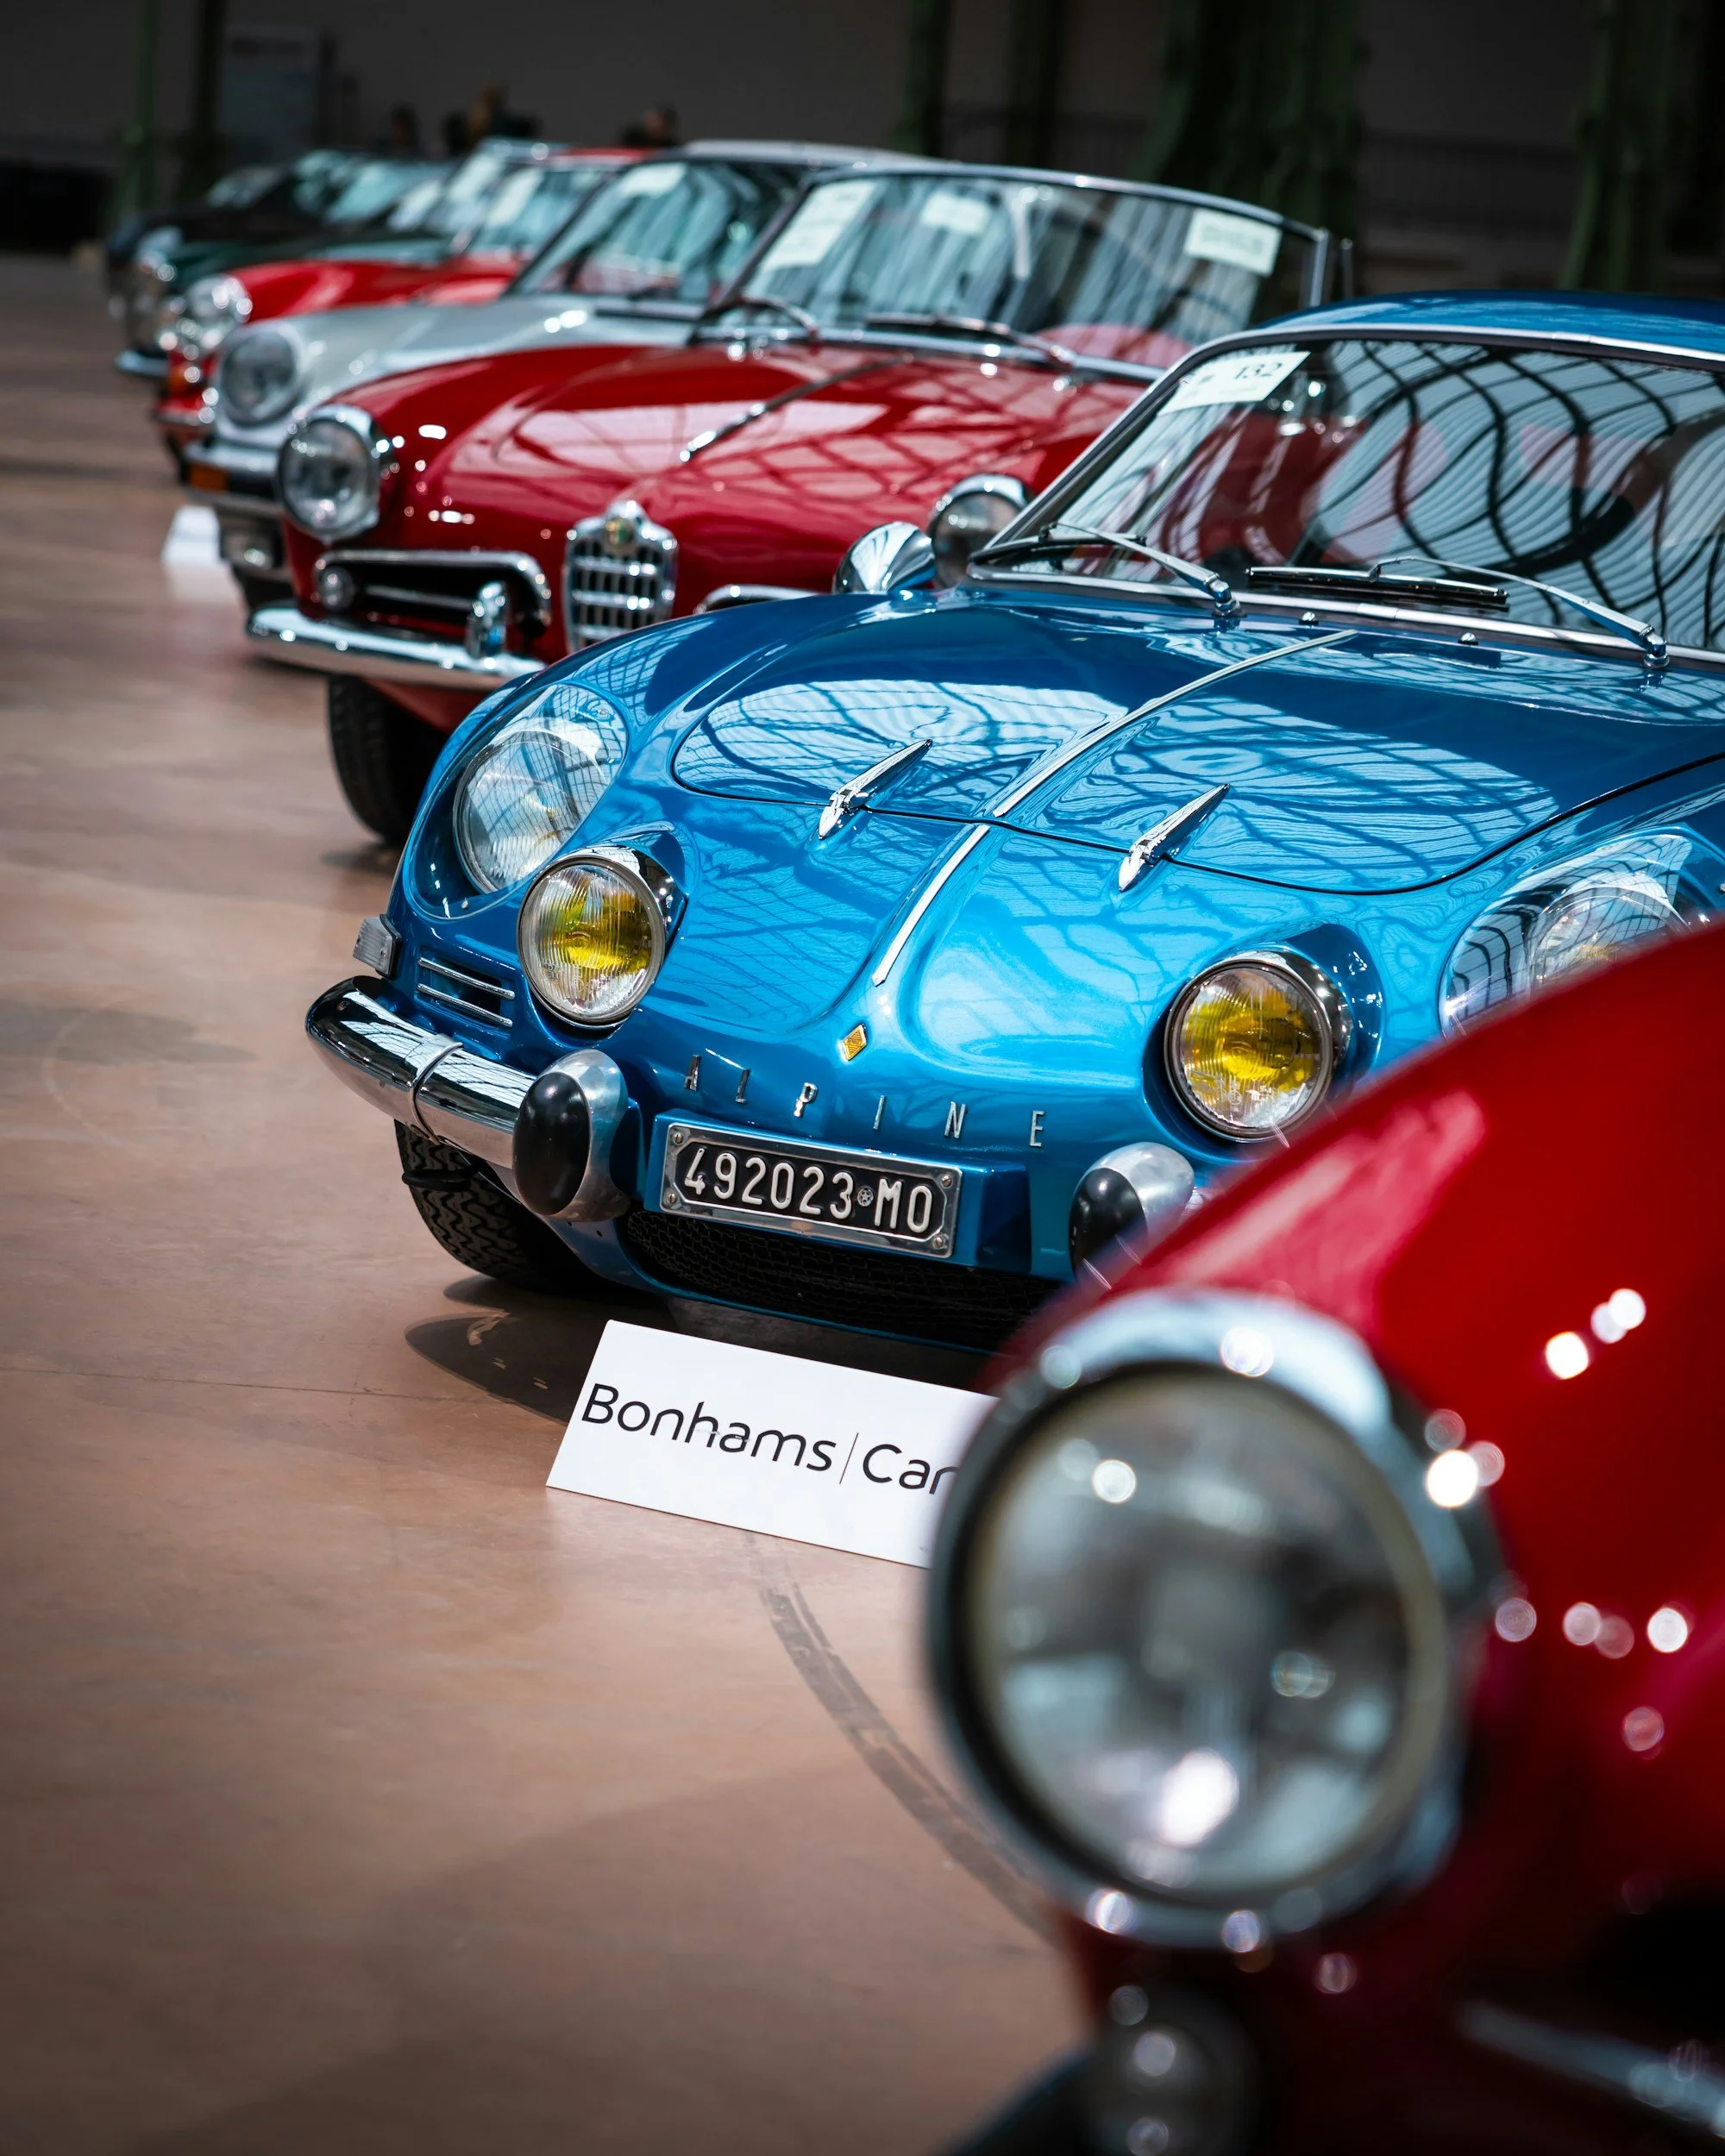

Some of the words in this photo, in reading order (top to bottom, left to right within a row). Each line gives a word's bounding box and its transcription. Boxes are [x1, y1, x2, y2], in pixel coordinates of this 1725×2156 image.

[684, 1055, 1046, 1147] ALPINE
[684, 1148, 855, 1219] 492023
[875, 1178, 932, 1233] MO
[580, 1382, 837, 1472] Bonhams
